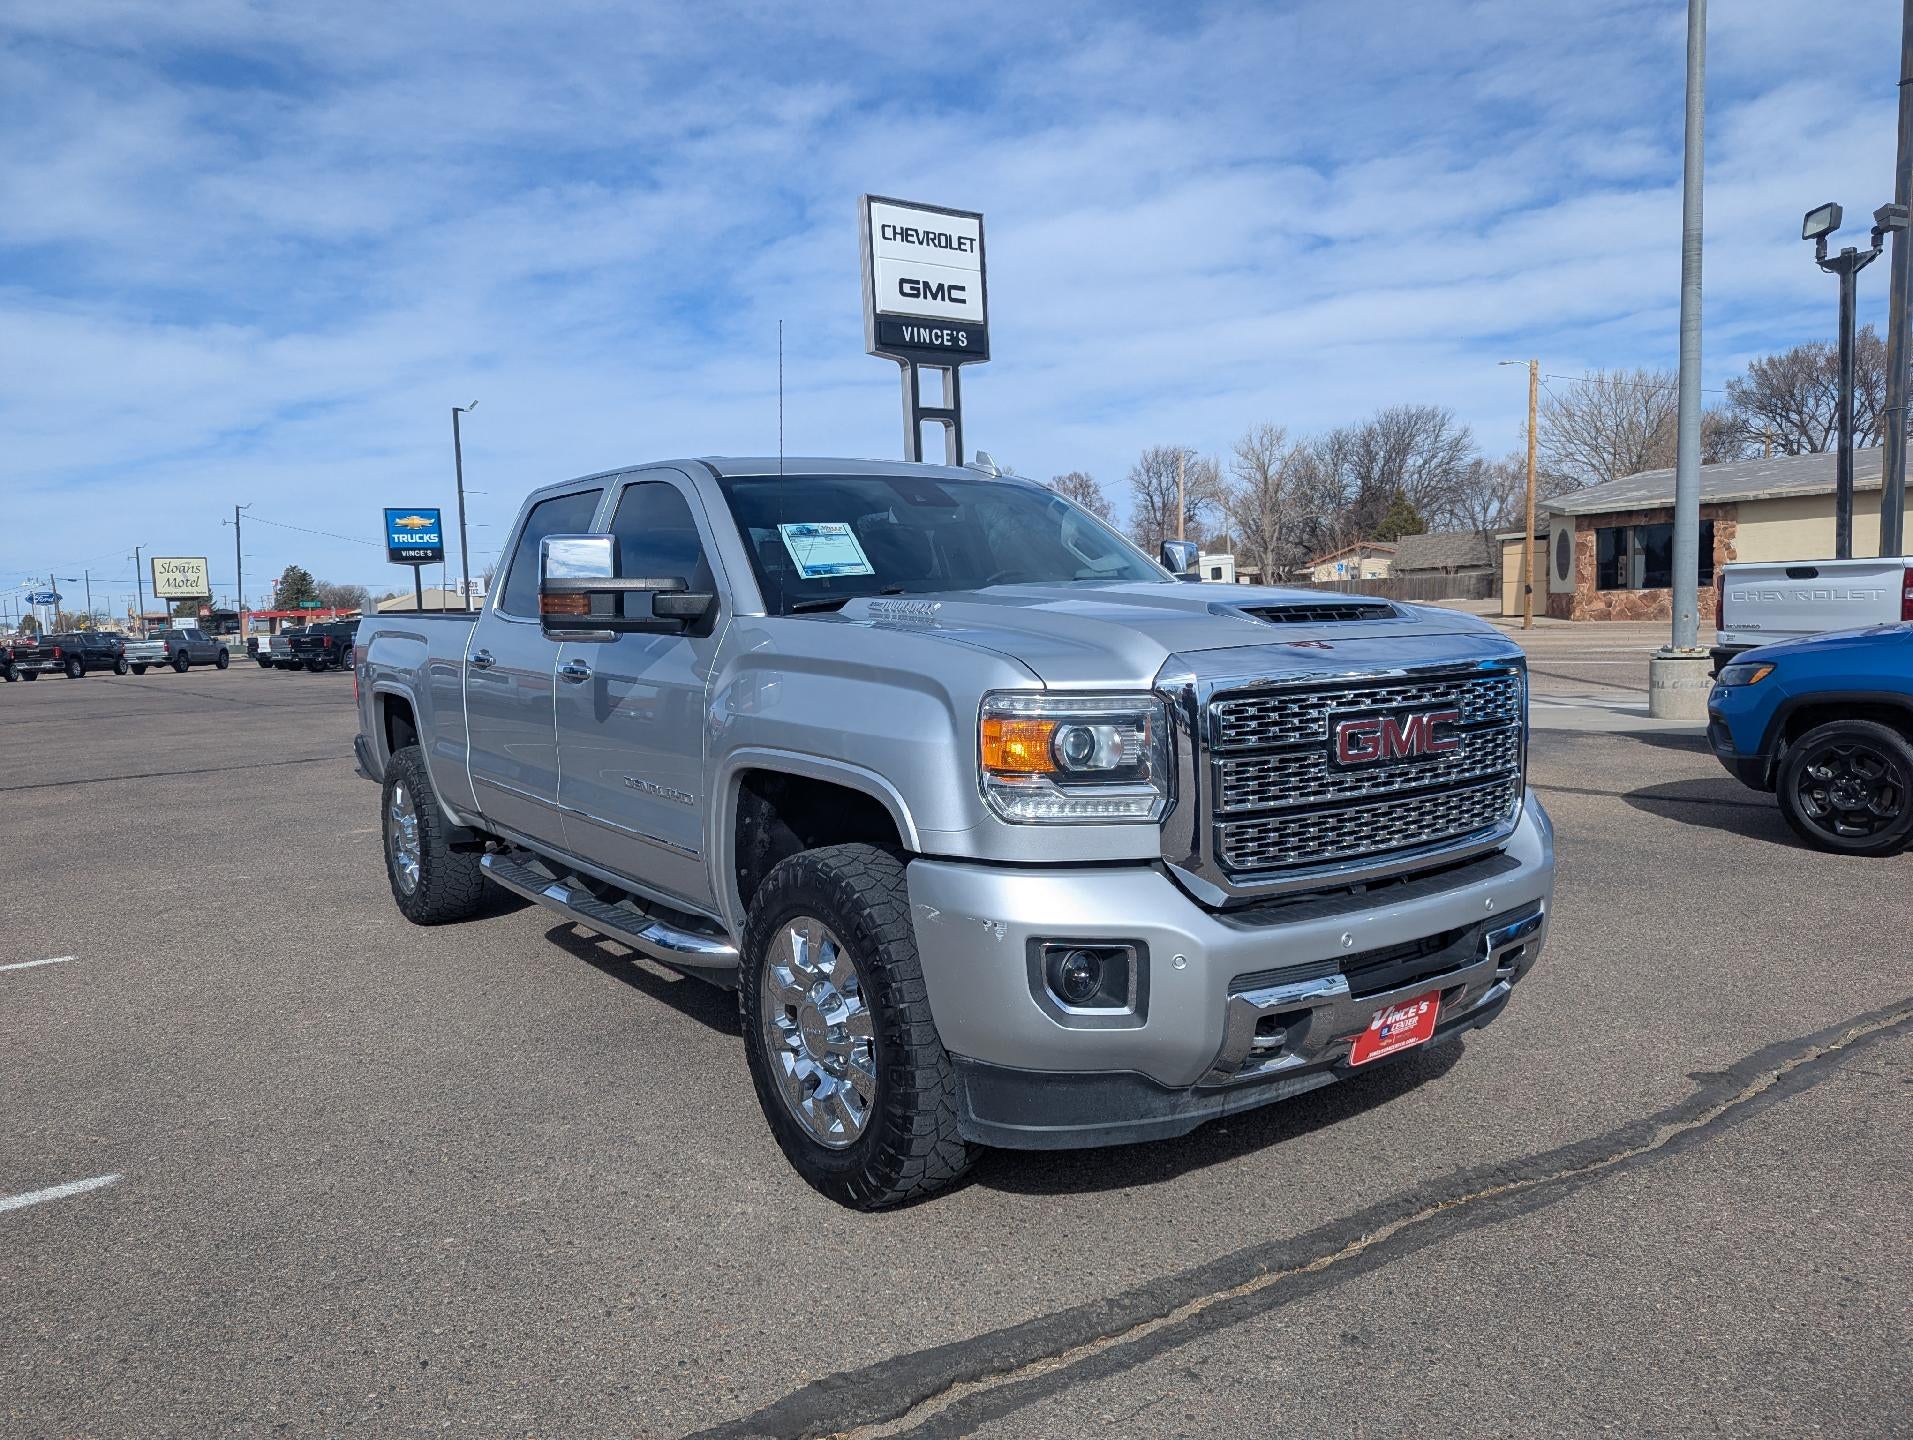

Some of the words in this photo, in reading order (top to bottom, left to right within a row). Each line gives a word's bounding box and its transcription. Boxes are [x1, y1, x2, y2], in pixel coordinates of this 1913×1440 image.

[881, 223, 976, 253] CHEVROLET
[899, 277, 967, 305] GMC
[902, 325, 968, 347] VINCE'S
[391, 533, 439, 543] TRUCKS
[162, 576, 200, 589] Motel
[1731, 589, 1886, 602] CHEVROLET
[1336, 709, 1459, 766] GMC
